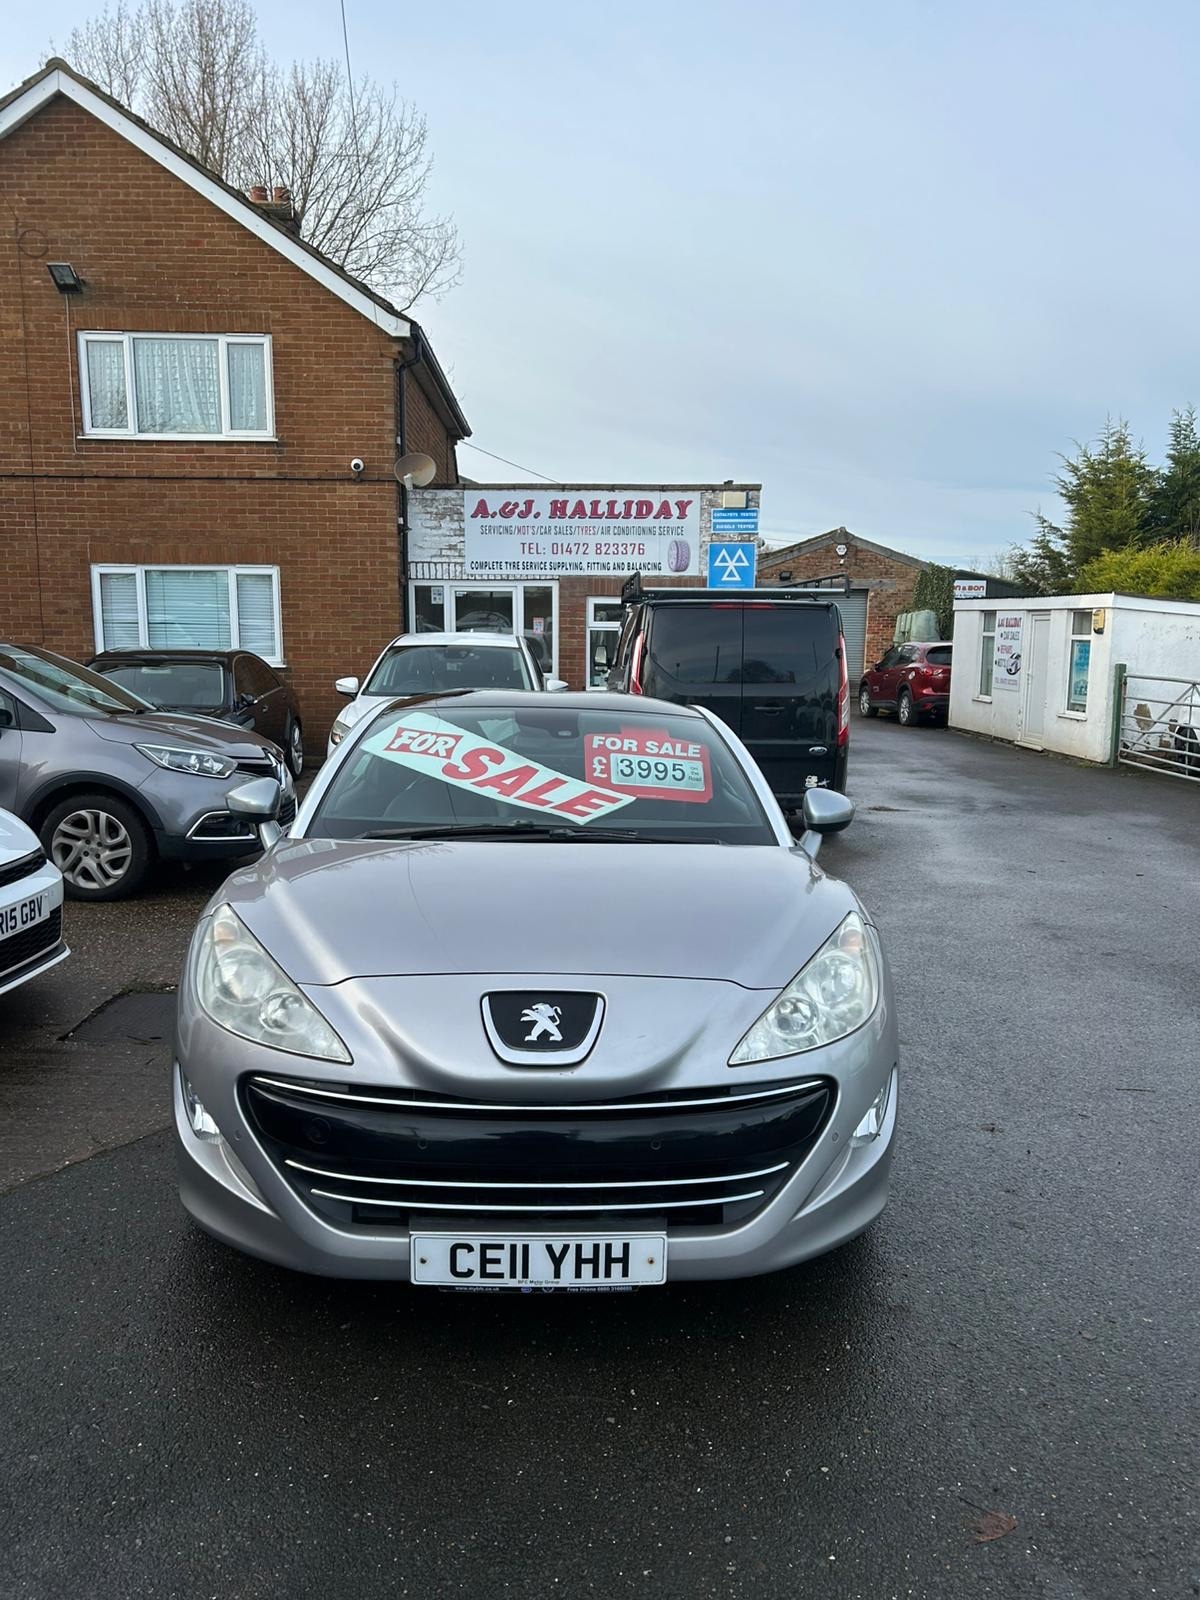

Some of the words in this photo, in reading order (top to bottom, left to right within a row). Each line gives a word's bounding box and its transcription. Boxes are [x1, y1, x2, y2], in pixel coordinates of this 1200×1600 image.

[549, 499, 693, 519] HALLIDAY
[613, 526, 656, 536] CONDITIONING
[658, 526, 684, 536] SERVICE
[520, 542, 546, 555] TEL:
[551, 542, 589, 555] 01472
[595, 543, 645, 555] 823376
[470, 561, 503, 571] COMPLETE
[505, 561, 520, 571] TYRE
[522, 561, 547, 571] SERVICE
[549, 561, 585, 572] SUPPLYING,
[587, 561, 611, 571] FITTING
[612, 561, 625, 571] AND
[626, 562, 662, 571] BALANCING
[592, 735, 638, 752] FOR
[645, 740, 701, 758] SALE
[391, 731, 457, 757] FOR
[441, 747, 624, 818] SALE
[619, 758, 686, 781] 3995
[21, 896, 43, 926] GBV
[449, 1242, 530, 1279] CE11
[545, 1242, 630, 1279] YHH
